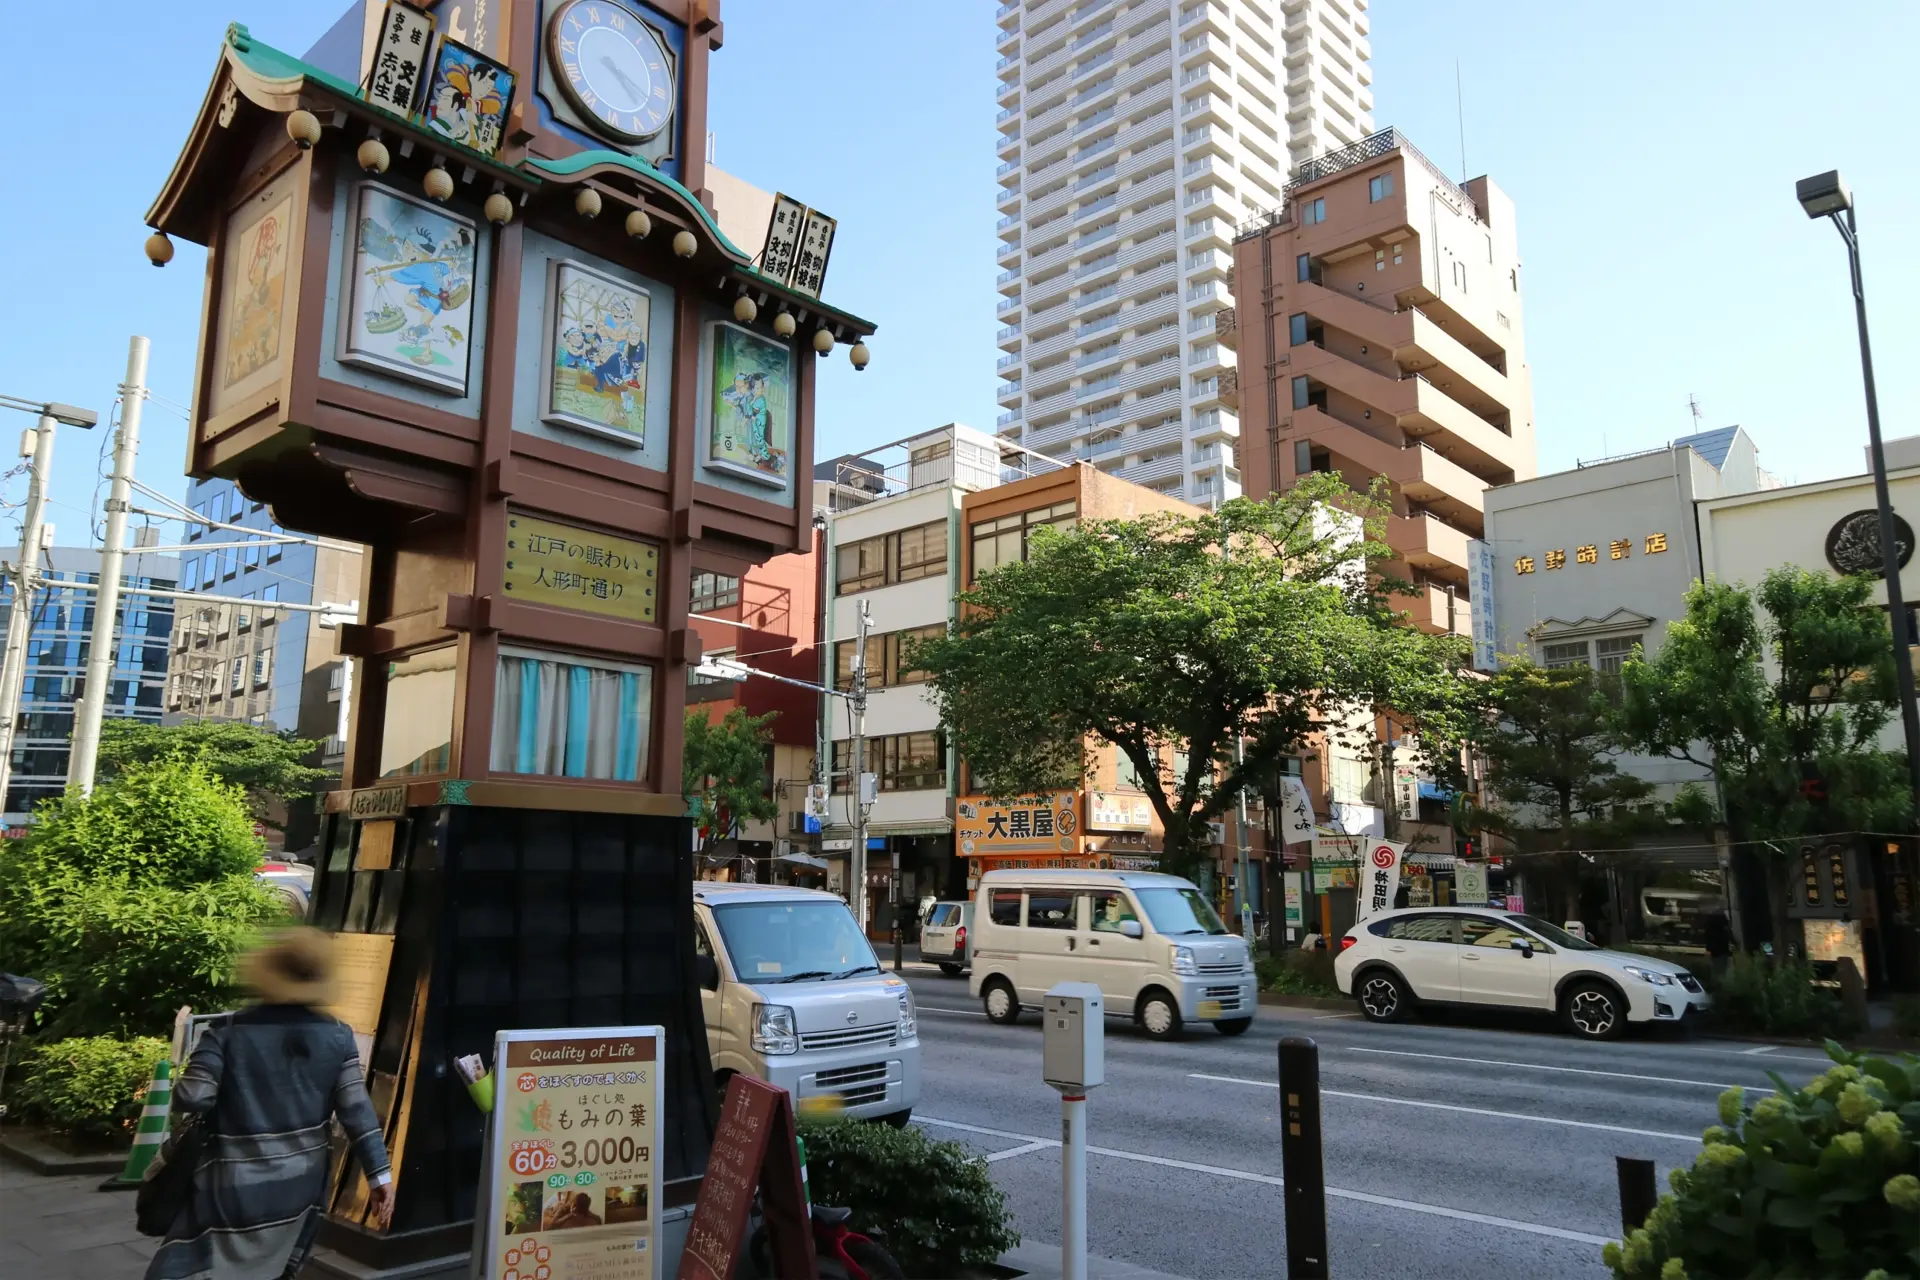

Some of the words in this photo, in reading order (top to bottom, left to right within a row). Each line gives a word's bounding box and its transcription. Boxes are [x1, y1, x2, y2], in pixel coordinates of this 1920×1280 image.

[374, 51, 399, 101] 志ん生
[528, 533, 639, 571] 江戸の賑わい
[1514, 532, 1668, 576] 佐野時計店
[532, 567, 624, 600] 人形町通り
[959, 828, 984, 839] チケット
[987, 808, 1054, 840] 大黒屋
[530, 1046, 585, 1062] Quality
[590, 1044, 606, 1058] of
[609, 1043, 635, 1057] Life
[519, 1070, 647, 1091] 芯をほぐすので長く効く
[578, 1093, 625, 1106] ほぐし処
[558, 1104, 647, 1130] もみの葉
[511, 1138, 555, 1150] 全身ほぐし
[560, 1136, 649, 1168] 3,000円
[515, 1150, 559, 1173] 60分
